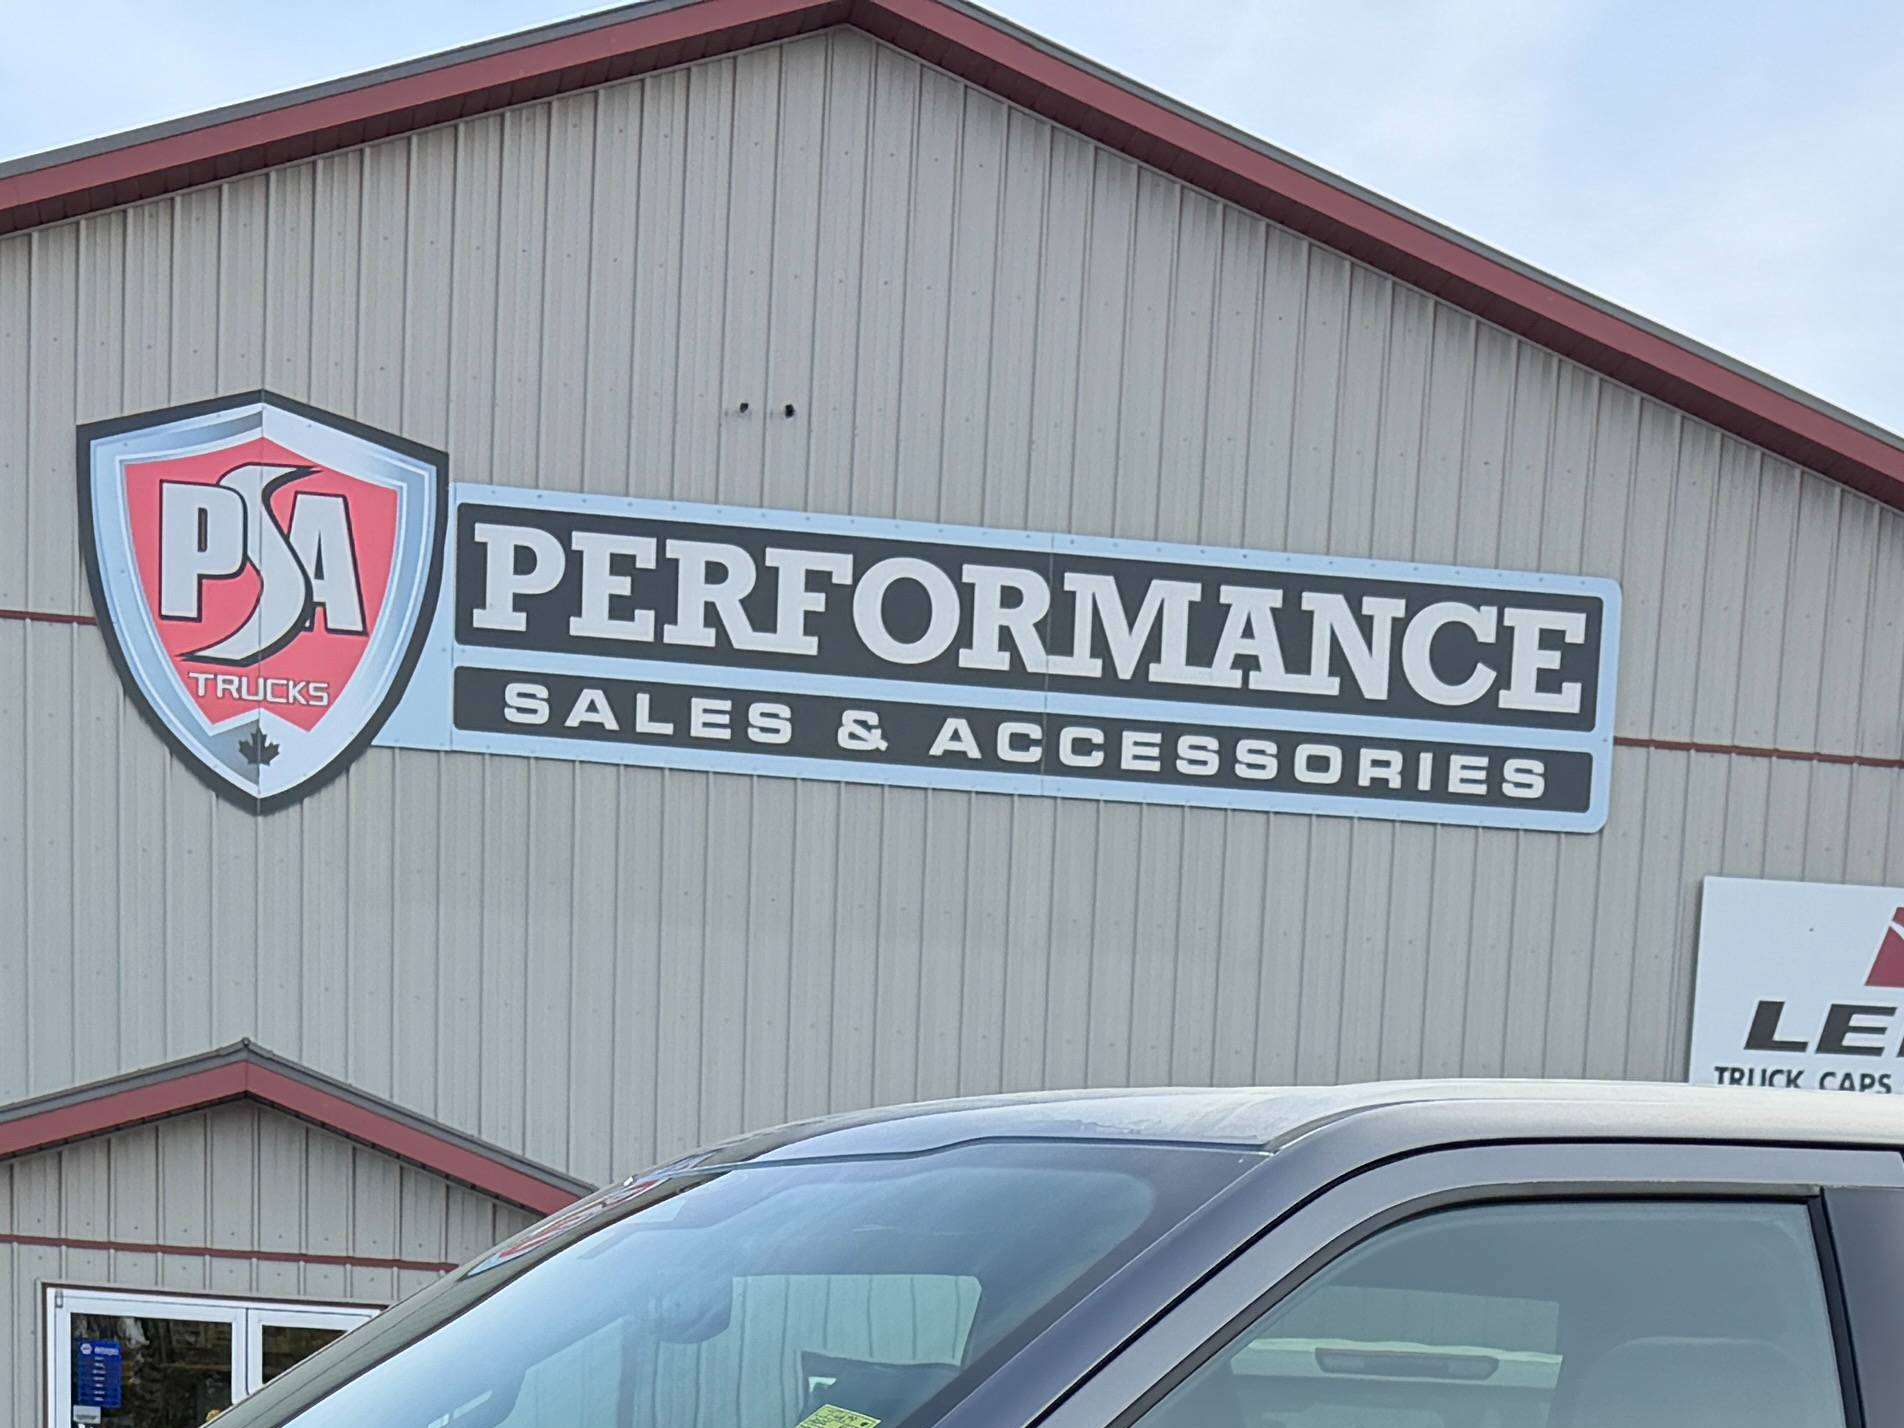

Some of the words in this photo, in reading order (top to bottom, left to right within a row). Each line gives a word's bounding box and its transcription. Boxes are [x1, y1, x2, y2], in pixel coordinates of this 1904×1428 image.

[159, 461, 370, 668] PSA
[472, 521, 1588, 715] PERFORMANCE
[188, 671, 330, 707] TRUCKS
[503, 682, 793, 745] SALES
[837, 709, 889, 752] &
[928, 716, 1547, 799] ACCESSORIES
[1713, 1065, 1805, 1089] TRUCK
[1819, 1071, 1893, 1095] CAPS
